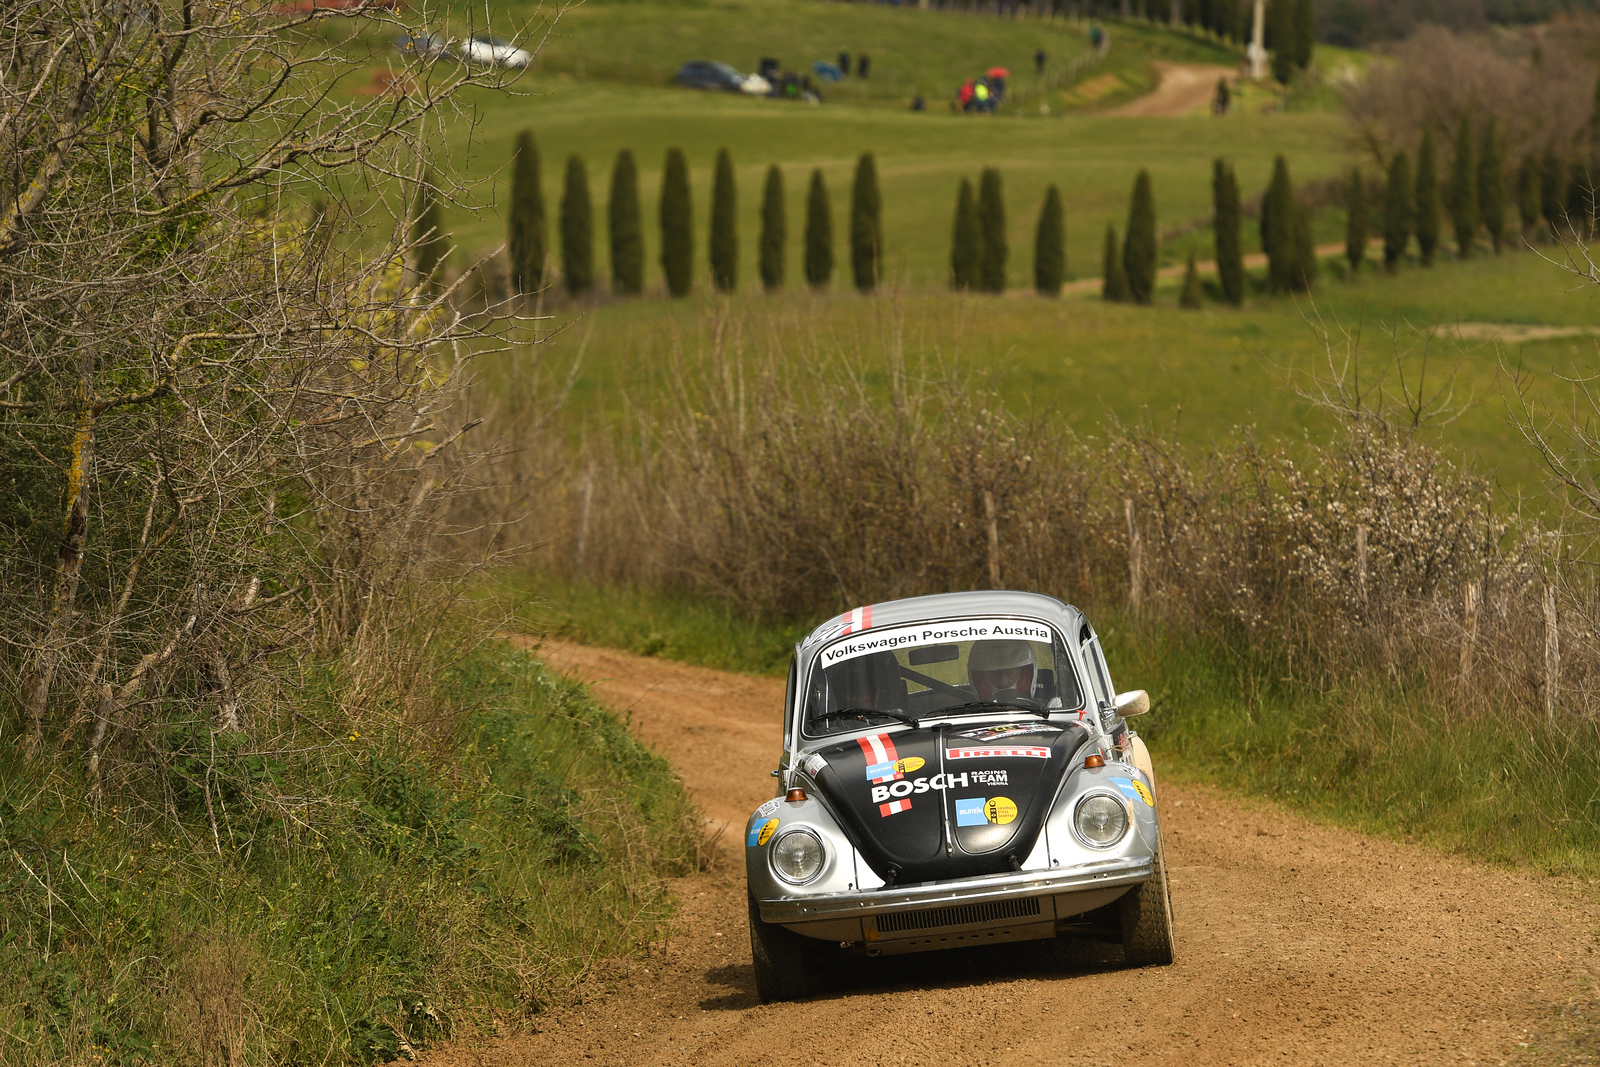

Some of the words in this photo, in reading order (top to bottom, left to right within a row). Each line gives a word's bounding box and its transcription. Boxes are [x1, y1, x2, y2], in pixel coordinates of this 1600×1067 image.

[826, 634, 917, 661] Volkswagen
[922, 627, 988, 640] Porsche
[992, 626, 1048, 638] Austria
[948, 746, 1048, 759] PIRELLI
[970, 774, 1008, 783] TEAM
[871, 772, 969, 804] BOSCH
[959, 807, 983, 815] BILSTEIN
